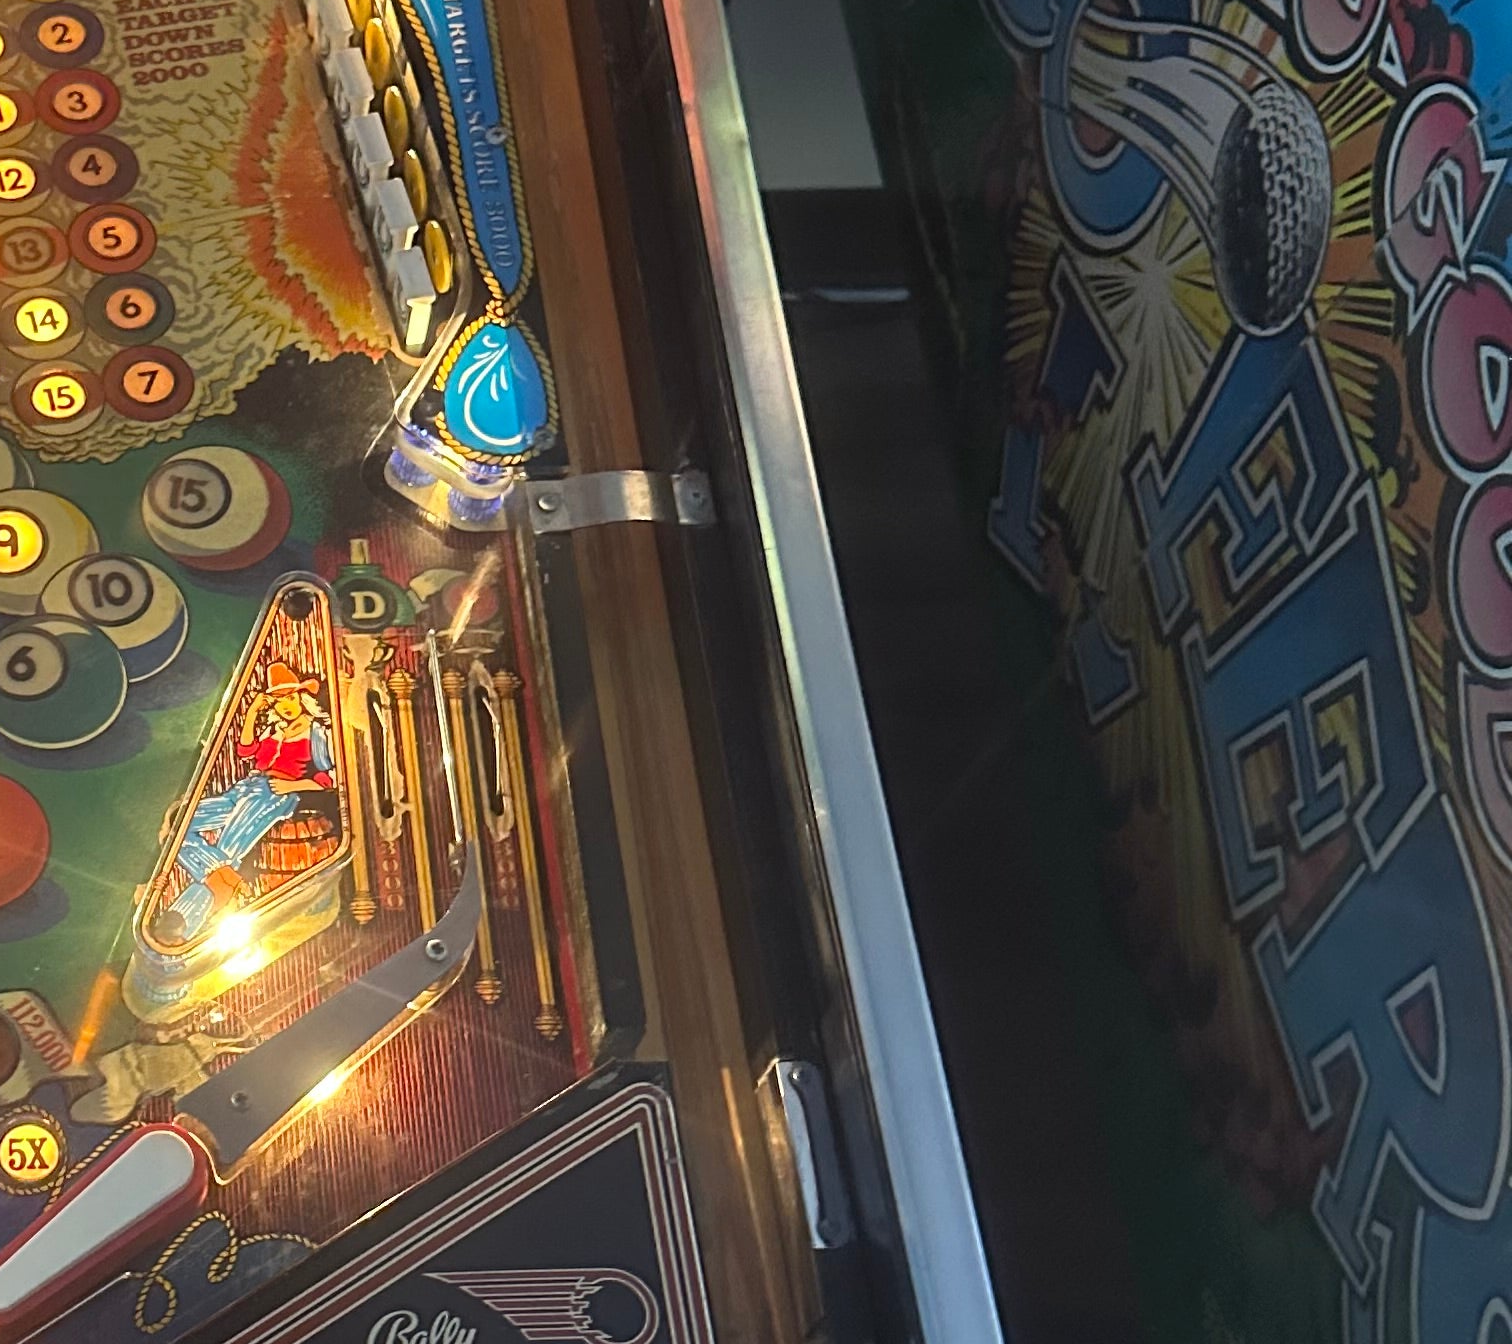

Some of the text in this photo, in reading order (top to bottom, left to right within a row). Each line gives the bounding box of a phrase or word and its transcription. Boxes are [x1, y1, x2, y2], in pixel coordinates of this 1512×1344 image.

[118, 2, 237, 32] TARGET
[51, 23, 73, 46] 2
[123, 24, 217, 51] DOWN
[129, 38, 246, 68] SCORES
[132, 62, 210, 86] 2000
[68, 91, 88, 113] 3
[81, 155, 102, 177] 4
[6, 237, 42, 264] 13
[103, 226, 122, 250] 5
[120, 295, 142, 319] 6
[25, 308, 60, 334] 14
[136, 369, 160, 396] 7
[42, 385, 76, 412] 15
[166, 475, 209, 513] 15
[87, 571, 134, 608] 10
[349, 590, 386, 620] D
[5, 644, 37, 681] 6
[4, 995, 74, 1072] 112,000
[7, 1137, 50, 1171] 5X
